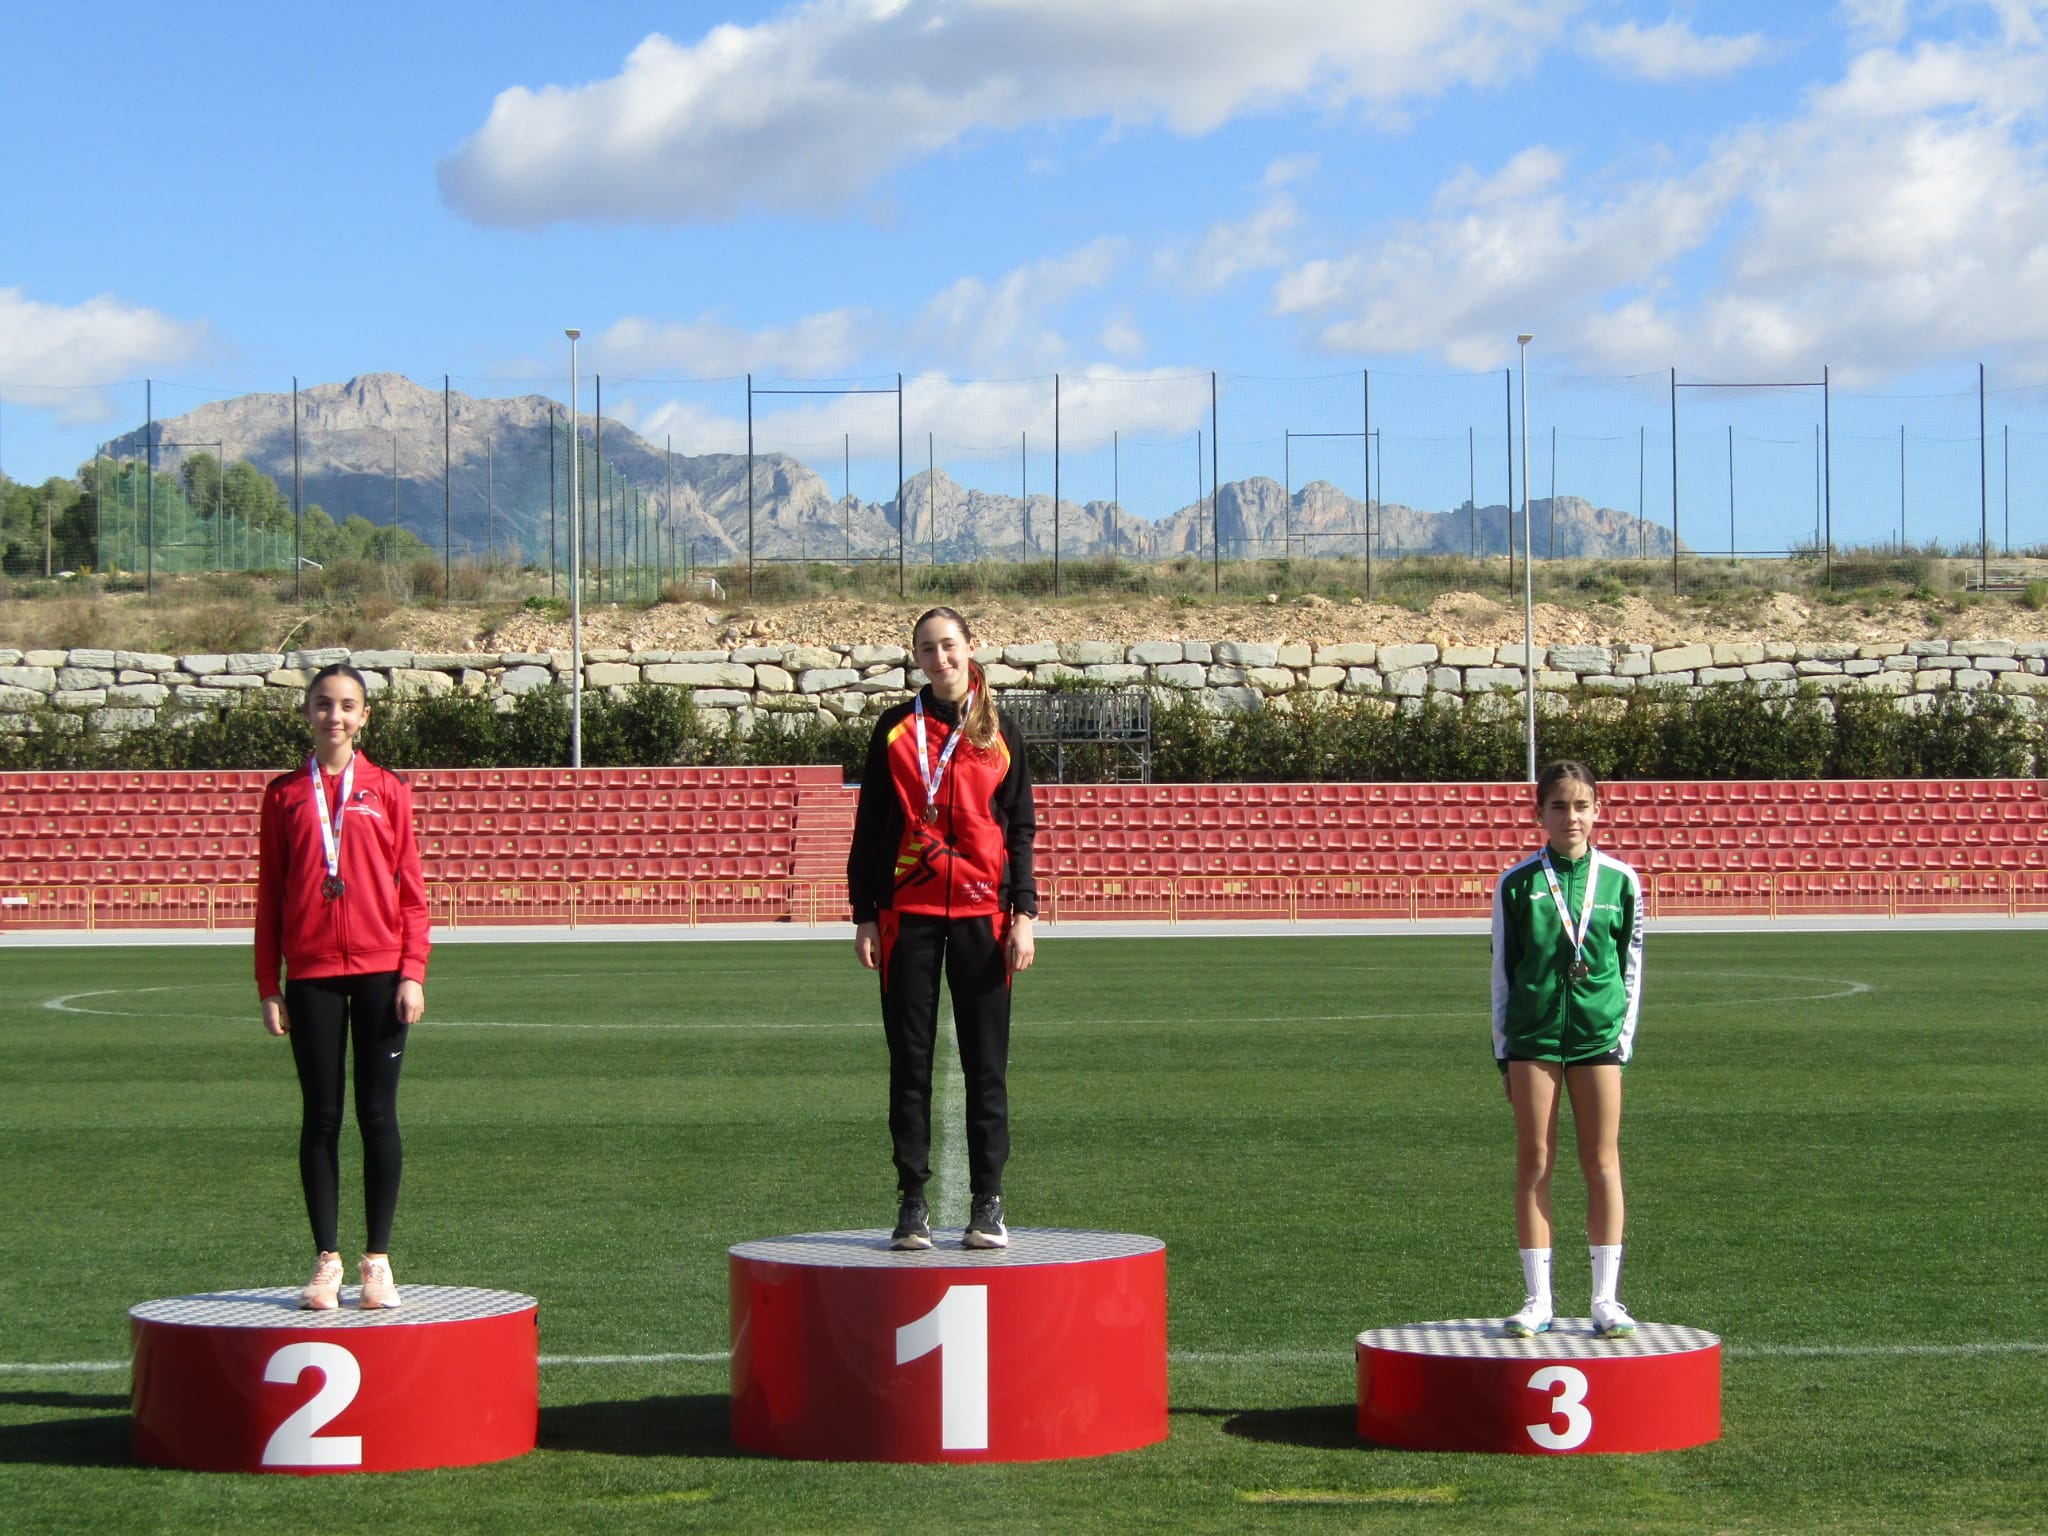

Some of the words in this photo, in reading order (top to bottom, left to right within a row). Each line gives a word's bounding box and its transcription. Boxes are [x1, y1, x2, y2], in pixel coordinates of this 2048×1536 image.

[262, 1342, 362, 1465] 2
[896, 1285, 988, 1449] 1
[1526, 1366, 1592, 1449] 3
